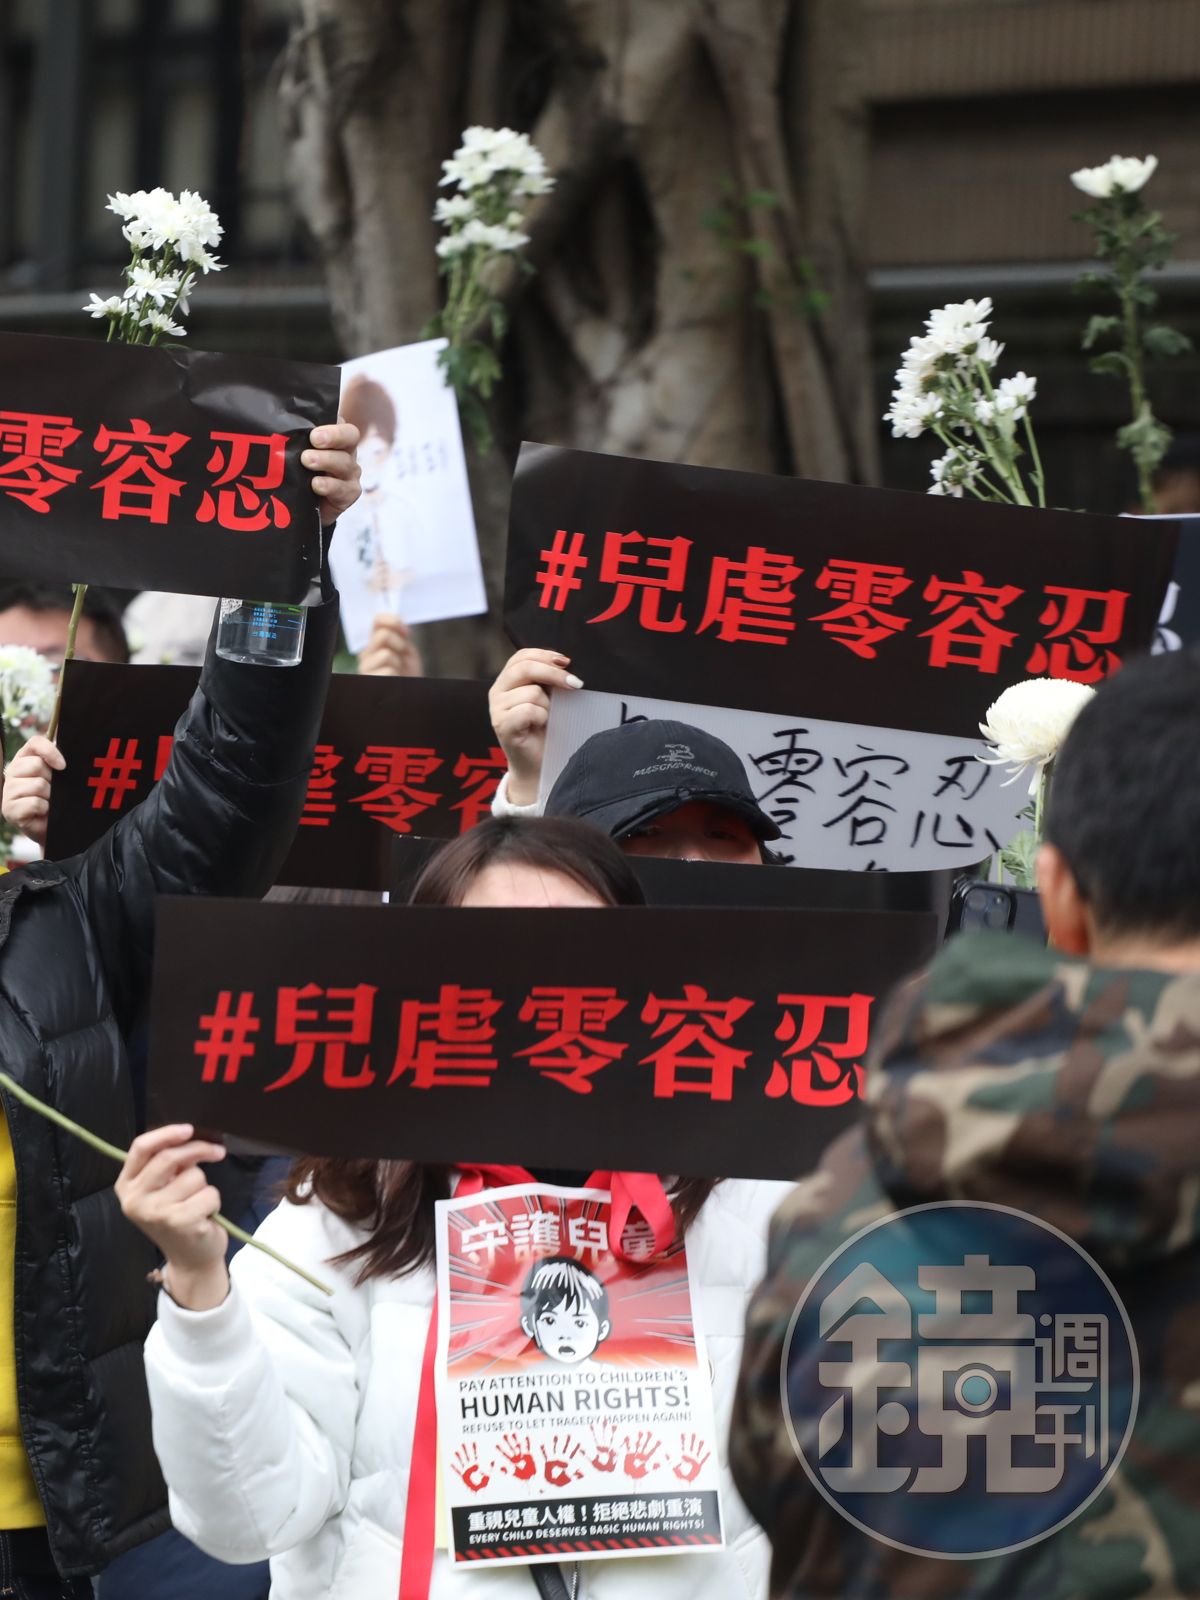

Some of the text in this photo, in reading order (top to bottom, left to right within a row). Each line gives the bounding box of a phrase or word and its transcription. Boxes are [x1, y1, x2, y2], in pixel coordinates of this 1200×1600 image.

[535, 530, 1131, 684] #兒虐零容忍
[194, 983, 876, 1108] #兒虐零容忍
[459, 1369, 688, 1392] PAY ATTENTION TO CHILDREN'S
[460, 1385, 690, 1419] HUMAN RIGHTS!
[462, 1422, 506, 1435] REFUSE
[509, 1420, 523, 1431] TO
[526, 1418, 546, 1429] LET
[653, 1410, 692, 1422] AGAIN!
[469, 1518, 705, 1545] EVERY CHILD DESERVES BASIC HUMAN RIGHTS!
